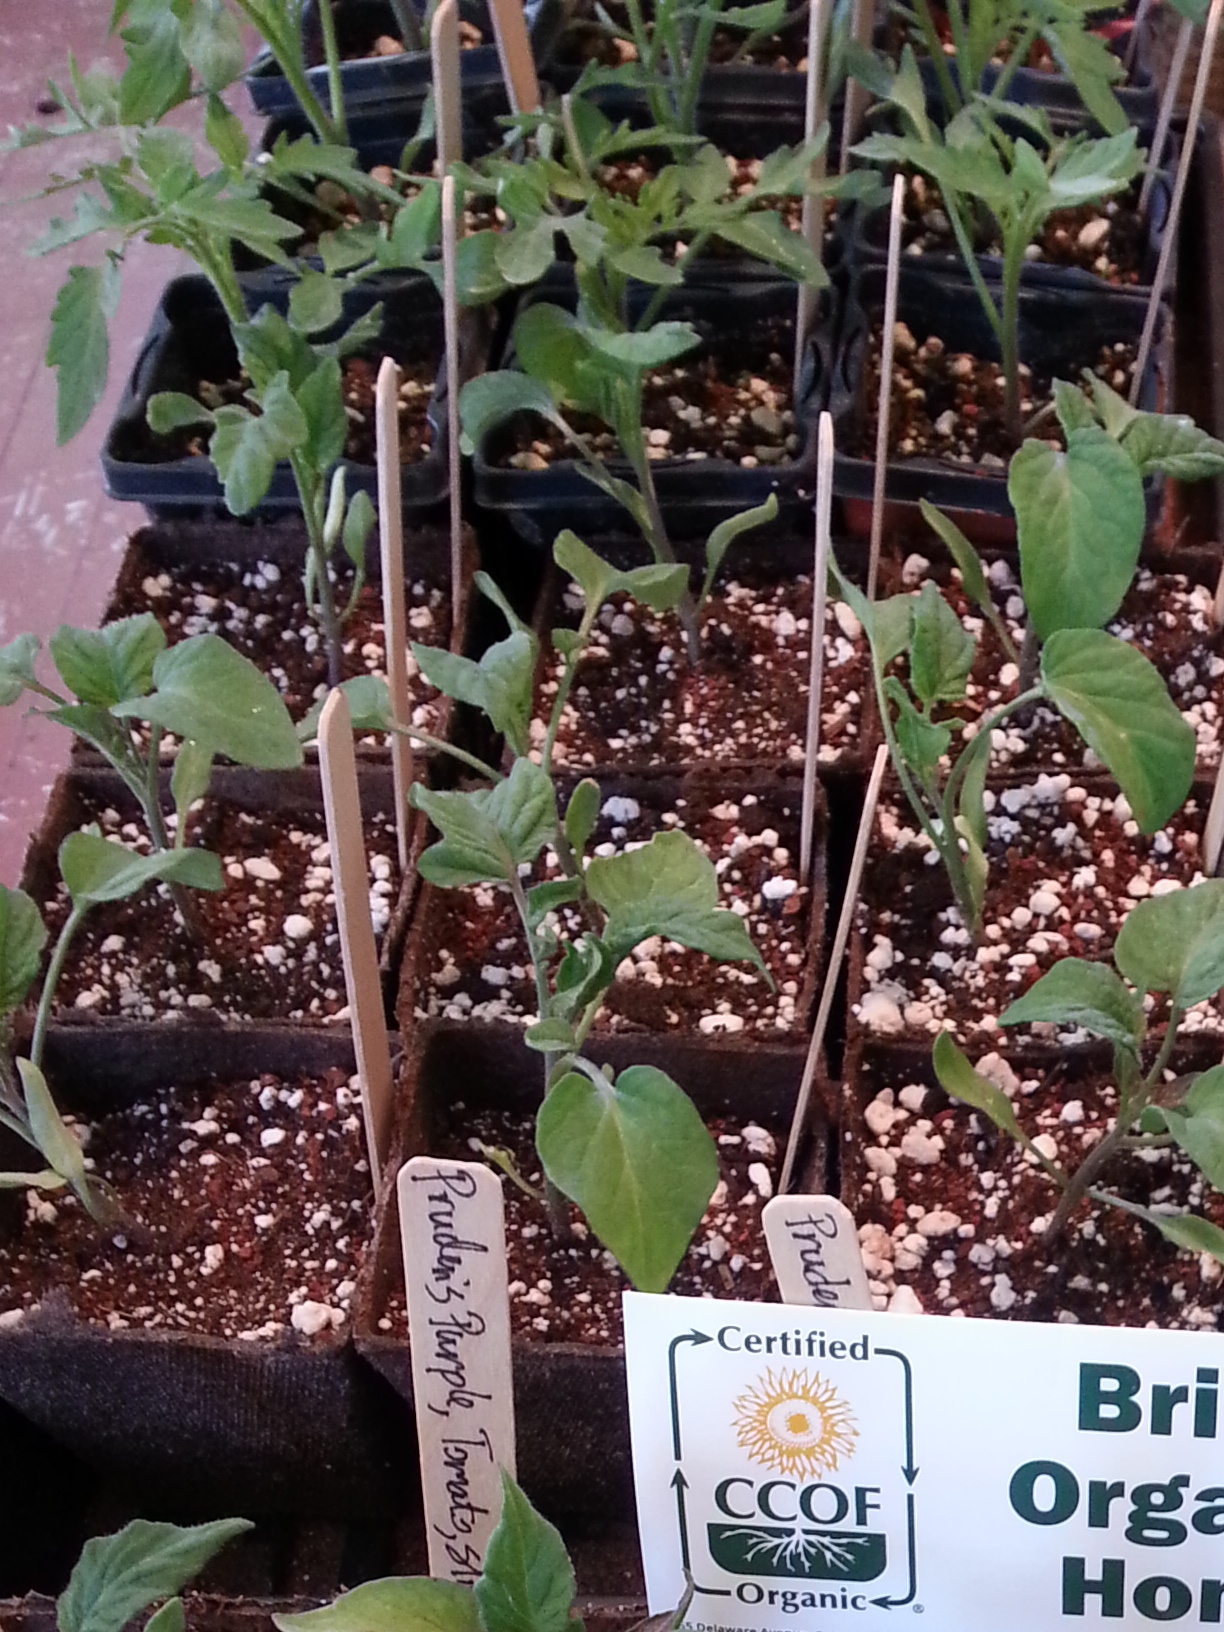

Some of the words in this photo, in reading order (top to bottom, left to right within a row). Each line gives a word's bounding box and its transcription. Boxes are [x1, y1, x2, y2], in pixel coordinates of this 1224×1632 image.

[717, 1326, 869, 1360] Certified
[714, 1477, 881, 1526] CCOF
[736, 1582, 867, 1612] Organic
